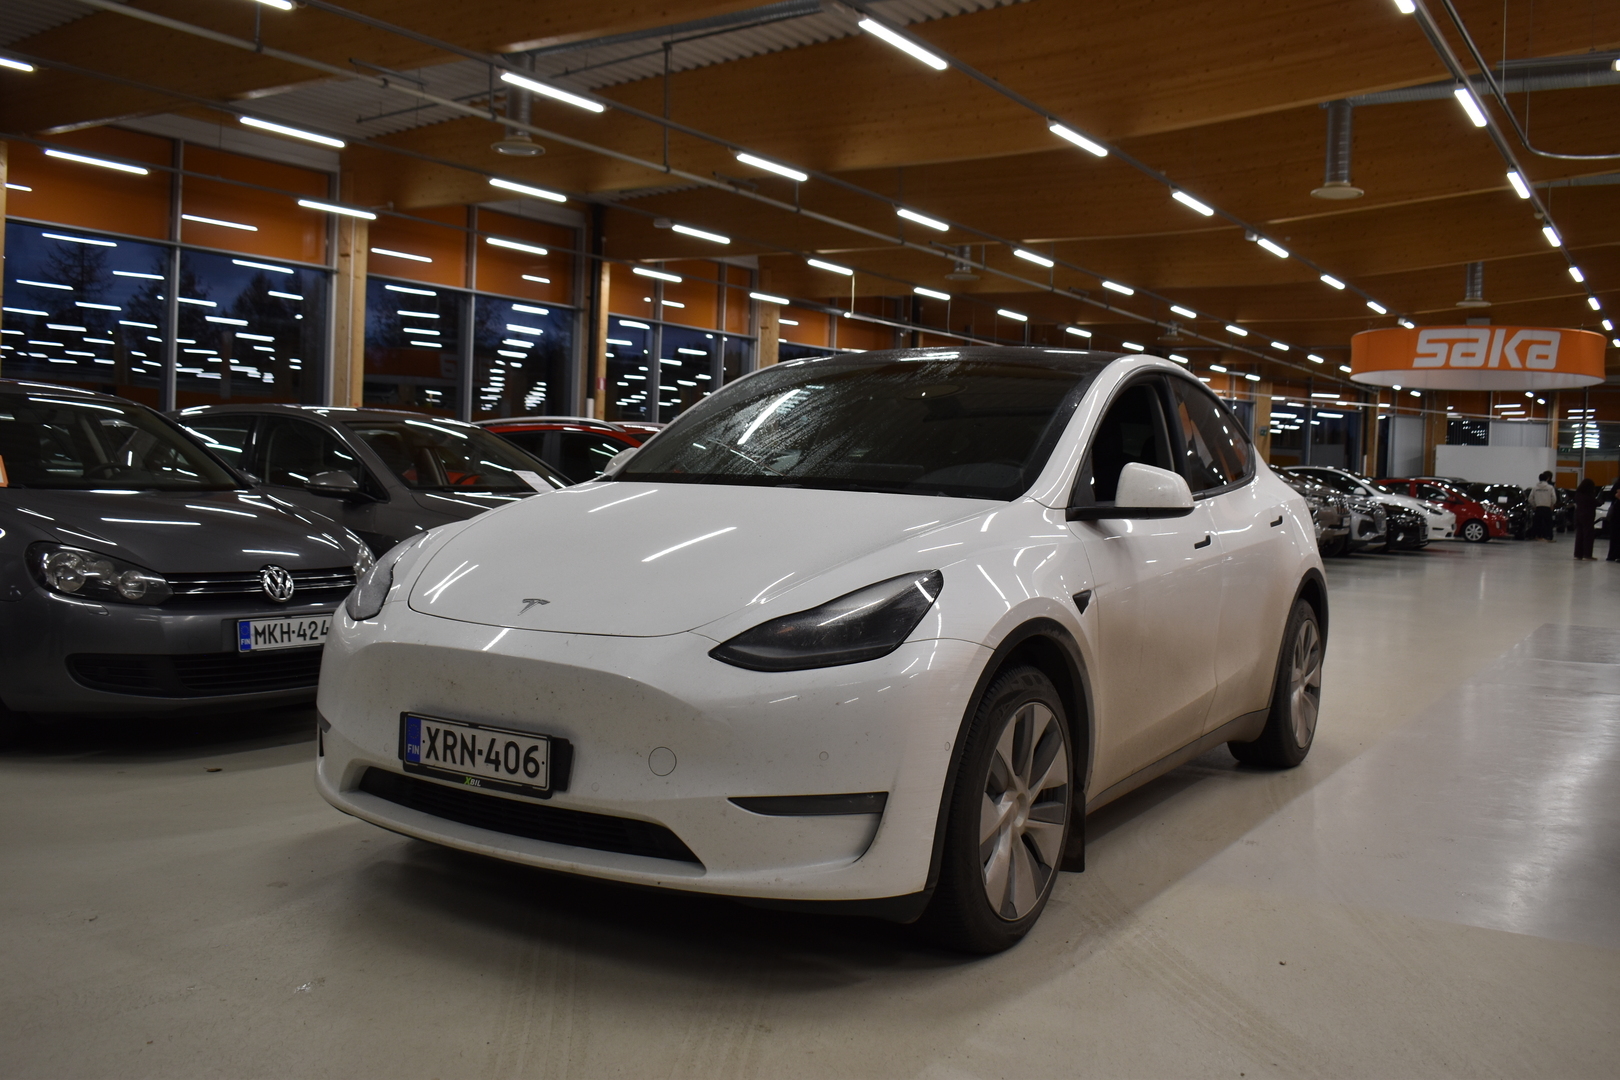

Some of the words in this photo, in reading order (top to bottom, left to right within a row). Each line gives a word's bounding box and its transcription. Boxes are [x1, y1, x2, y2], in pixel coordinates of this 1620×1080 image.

[240, 638, 251, 646] FIN
[407, 743, 420, 756] FIN
[425, 726, 540, 779] XRN-406
